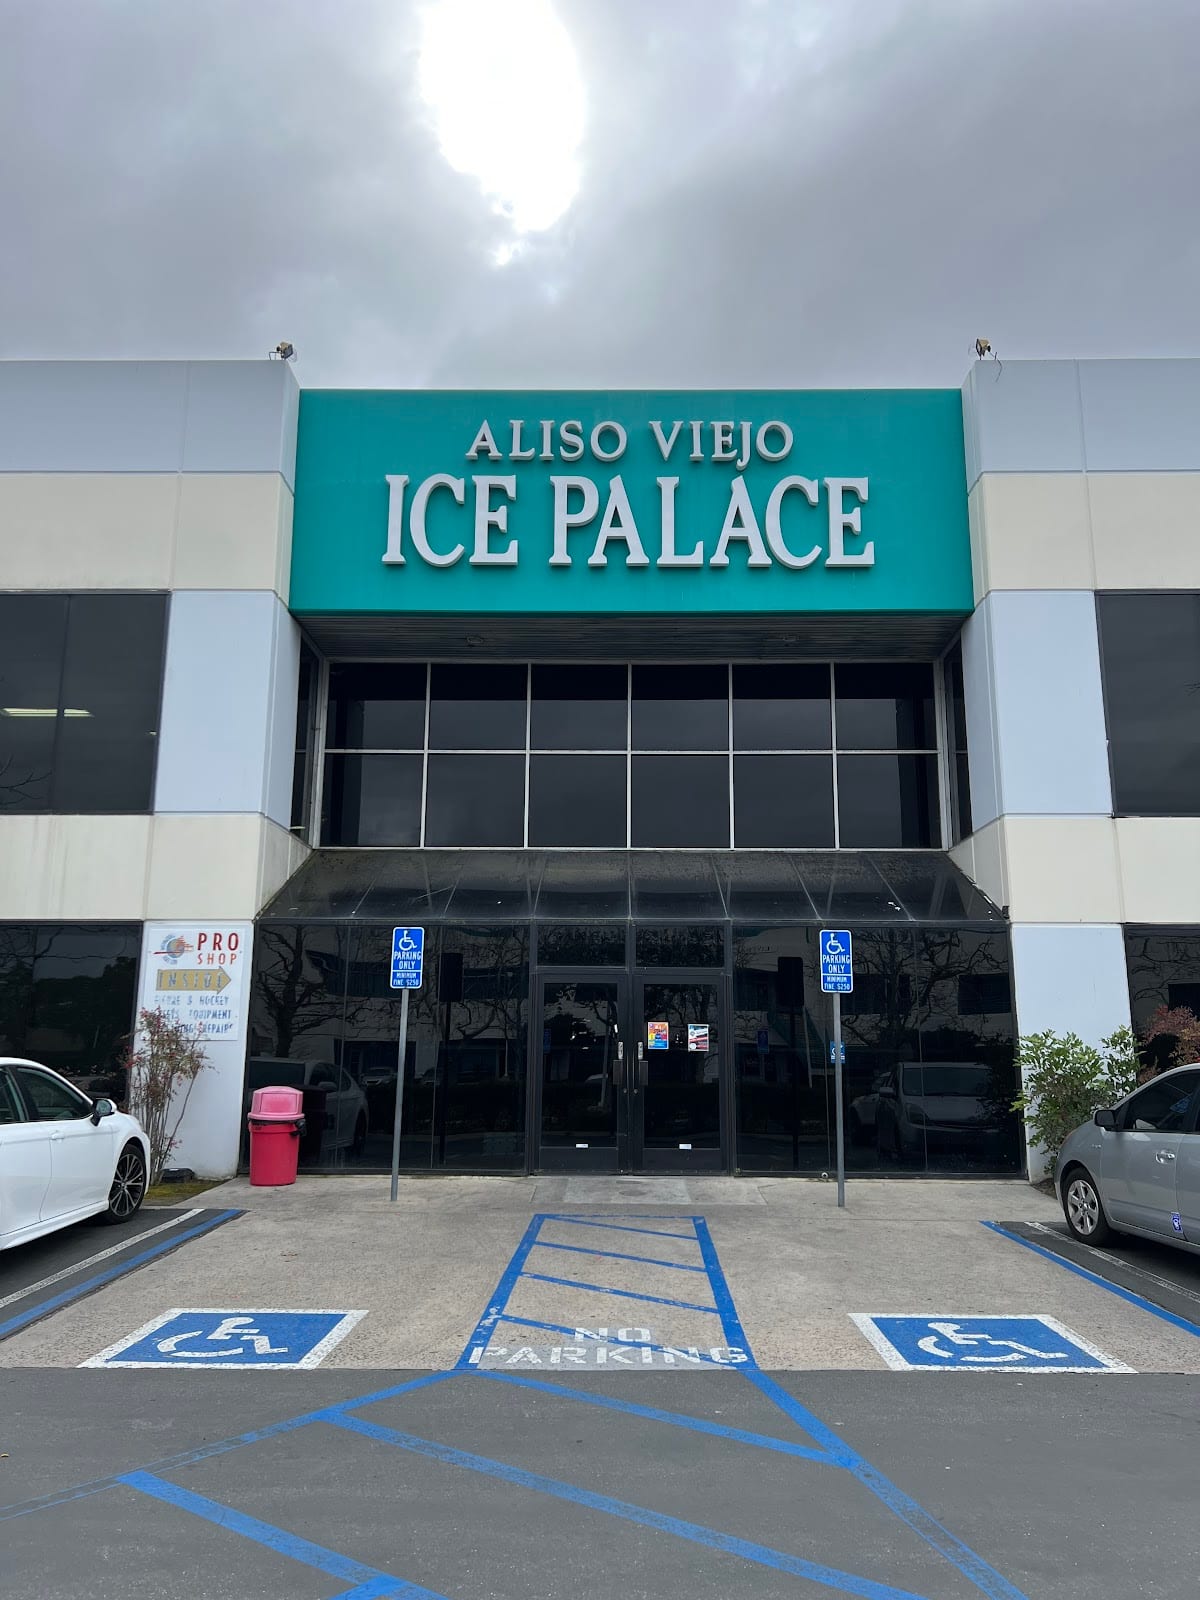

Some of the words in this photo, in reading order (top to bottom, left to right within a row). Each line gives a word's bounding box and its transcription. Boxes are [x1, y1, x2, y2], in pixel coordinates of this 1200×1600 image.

[465, 418, 628, 462] ALISO
[648, 420, 794, 471] VIEJO
[381, 473, 518, 567] ICE
[548, 474, 876, 569] PALACE
[197, 932, 239, 951] PRO
[197, 953, 237, 965] SHOP
[394, 951, 422, 960] PARKING
[823, 954, 850, 964] PARKING
[399, 960, 416, 970] ONLY
[828, 964, 845, 974] ONLY
[199, 995, 229, 1006] HOCKEY
[574, 1327, 652, 1342] NO
[468, 1346, 749, 1364] PARKING
